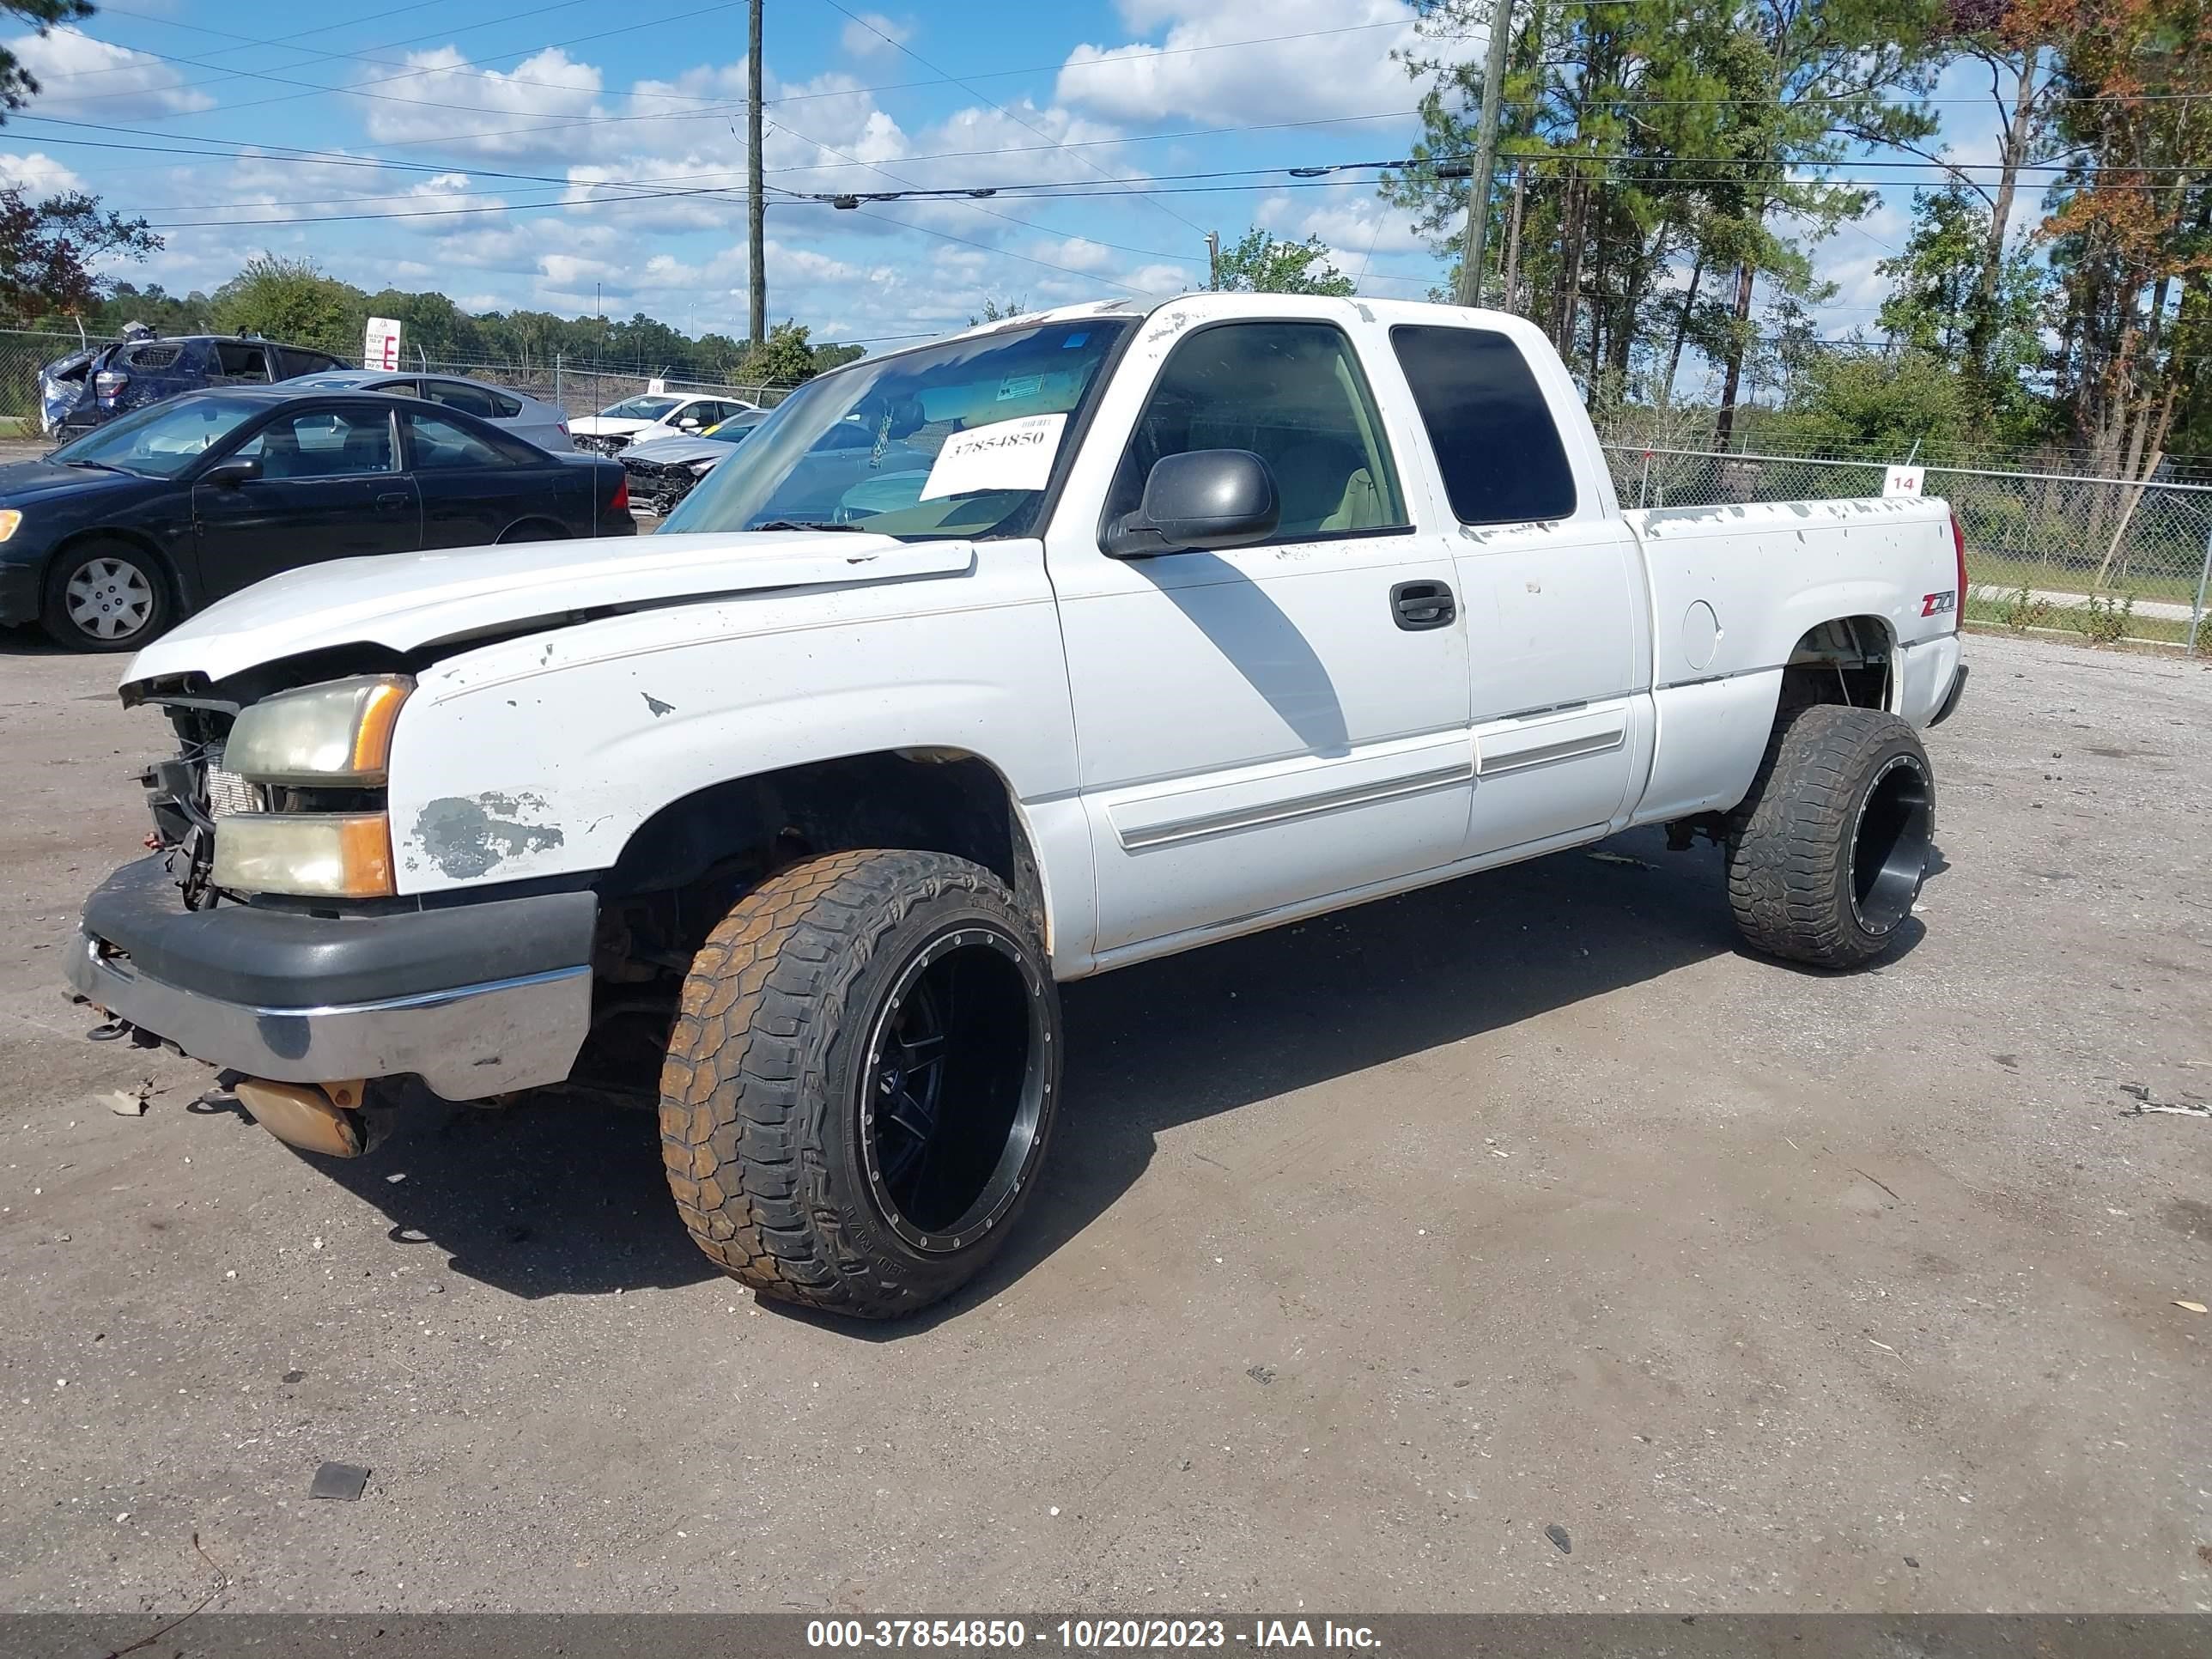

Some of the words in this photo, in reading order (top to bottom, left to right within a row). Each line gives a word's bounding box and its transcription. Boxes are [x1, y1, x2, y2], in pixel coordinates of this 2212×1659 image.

[949, 431, 1045, 459] 37854850
[1894, 477, 1915, 490] 14
[1920, 590, 1956, 618] Z71
